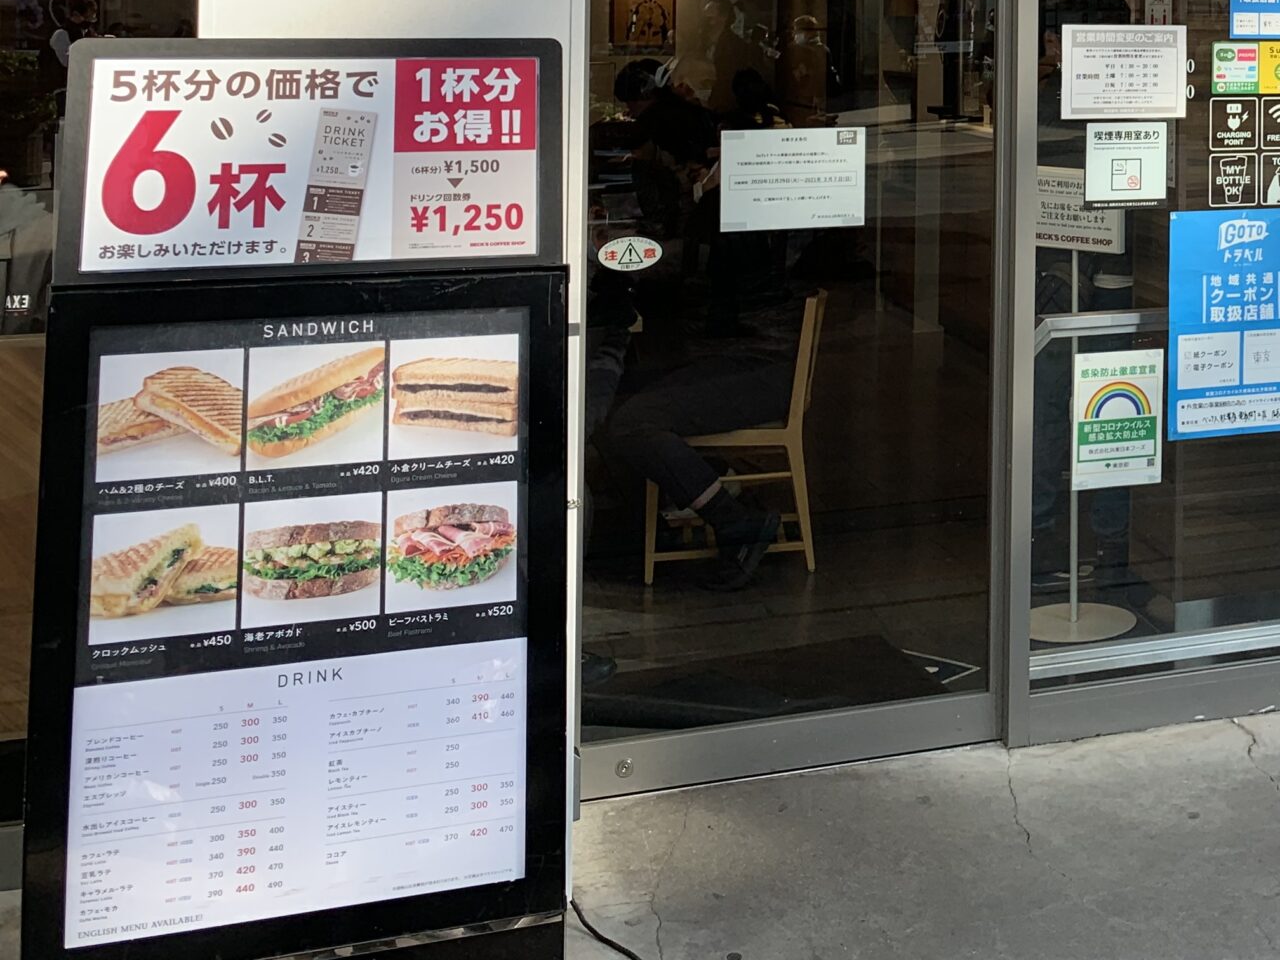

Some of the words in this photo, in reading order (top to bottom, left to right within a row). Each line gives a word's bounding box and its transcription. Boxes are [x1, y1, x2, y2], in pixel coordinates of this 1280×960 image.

[1076, 31, 1174, 43] 営業時間変更のご案内
[109, 69, 379, 103] 5杯分の価格で
[415, 66, 522, 104] 1杯分
[324, 125, 365, 138] DRINK
[1093, 130, 1160, 141] 喫煙専用室あり
[1216, 131, 1252, 139] CHARGING
[323, 136, 365, 148] TICKET
[101, 109, 288, 236] 6杯
[411, 166, 442, 175] (6杯分)
[444, 159, 500, 175] ¥1,500
[1226, 165, 1241, 175] MY
[1216, 175, 1251, 185] BOTTLE
[313, 196, 319, 210] 1
[410, 193, 471, 202] ドリンク回数券
[410, 202, 524, 236] ¥1,250
[1040, 211, 1107, 224] ご注文をお願いします
[306, 224, 315, 237] 2
[1060, 234, 1091, 245] COFFEE
[1091, 237, 1113, 247] SHOP
[98, 238, 288, 261] お楽しみいただけます。
[1223, 248, 1264, 263] トラベル
[1210, 271, 1274, 288] 地域共通
[1210, 287, 1274, 304] クーポン
[1210, 303, 1275, 322] 取扱店舗
[263, 319, 375, 339] SANDWICH
[1193, 349, 1228, 359] 紙クーポン
[1080, 365, 1157, 379] 感染防止徹底宣言
[1193, 361, 1234, 372] 電子クーポン
[1083, 420, 1151, 433] 新型コロナウイルス
[1088, 429, 1147, 442] 感染拡大防止中
[391, 458, 471, 474] 小倉クリームチーズ
[489, 454, 515, 466] ¥420
[352, 464, 380, 477] ¥420
[209, 475, 238, 487] ¥400
[249, 474, 275, 484] B.L.T.
[98, 480, 185, 496] ハム&2種のチーズ
[488, 605, 514, 617] ¥520
[349, 619, 377, 632] ¥500
[203, 634, 232, 647] ¥450
[244, 627, 303, 643] 海老アボカド
[91, 643, 167, 660] クロックムッシュ
[278, 667, 344, 689] DRINK
[446, 697, 460, 706] 340
[472, 693, 489, 702] 390
[501, 692, 515, 700] 440
[446, 716, 460, 725] 360
[472, 711, 489, 721] 410
[500, 709, 515, 718] 460
[86, 734, 145, 746] ブレンドコーヒー
[213, 722, 229, 730] 250
[241, 717, 260, 727] 300
[272, 715, 287, 724] 350
[212, 740, 228, 749] 250
[240, 735, 259, 745] 300
[272, 733, 287, 742] 350
[446, 743, 460, 752] 250
[85, 770, 150, 783] アメリカンコーヒー
[212, 758, 228, 767] 250
[240, 753, 259, 764] 300
[271, 751, 287, 760] 350
[445, 761, 460, 769] 250
[211, 776, 227, 785] 250
[271, 769, 286, 778] 350
[445, 787, 459, 797] 250
[471, 782, 488, 793] 300
[500, 780, 514, 789] 350
[210, 805, 226, 814] 250
[238, 799, 257, 810] 300
[270, 797, 286, 806] 350
[445, 805, 459, 814] 250
[470, 800, 488, 811] 300
[500, 798, 514, 806] 350
[237, 828, 257, 839] 350
[269, 825, 285, 835] 400
[470, 827, 488, 837] 420
[499, 825, 514, 834] 470
[208, 852, 224, 861] 340
[236, 847, 256, 857] 390
[268, 844, 284, 853] 440
[208, 870, 224, 880] 370
[236, 865, 256, 875] 420
[268, 862, 283, 871] 470
[207, 889, 223, 898] 390
[235, 883, 255, 894] 440
[267, 880, 283, 890] 490
[78, 925, 118, 940] ENGLISH
[120, 922, 149, 933] MENU
